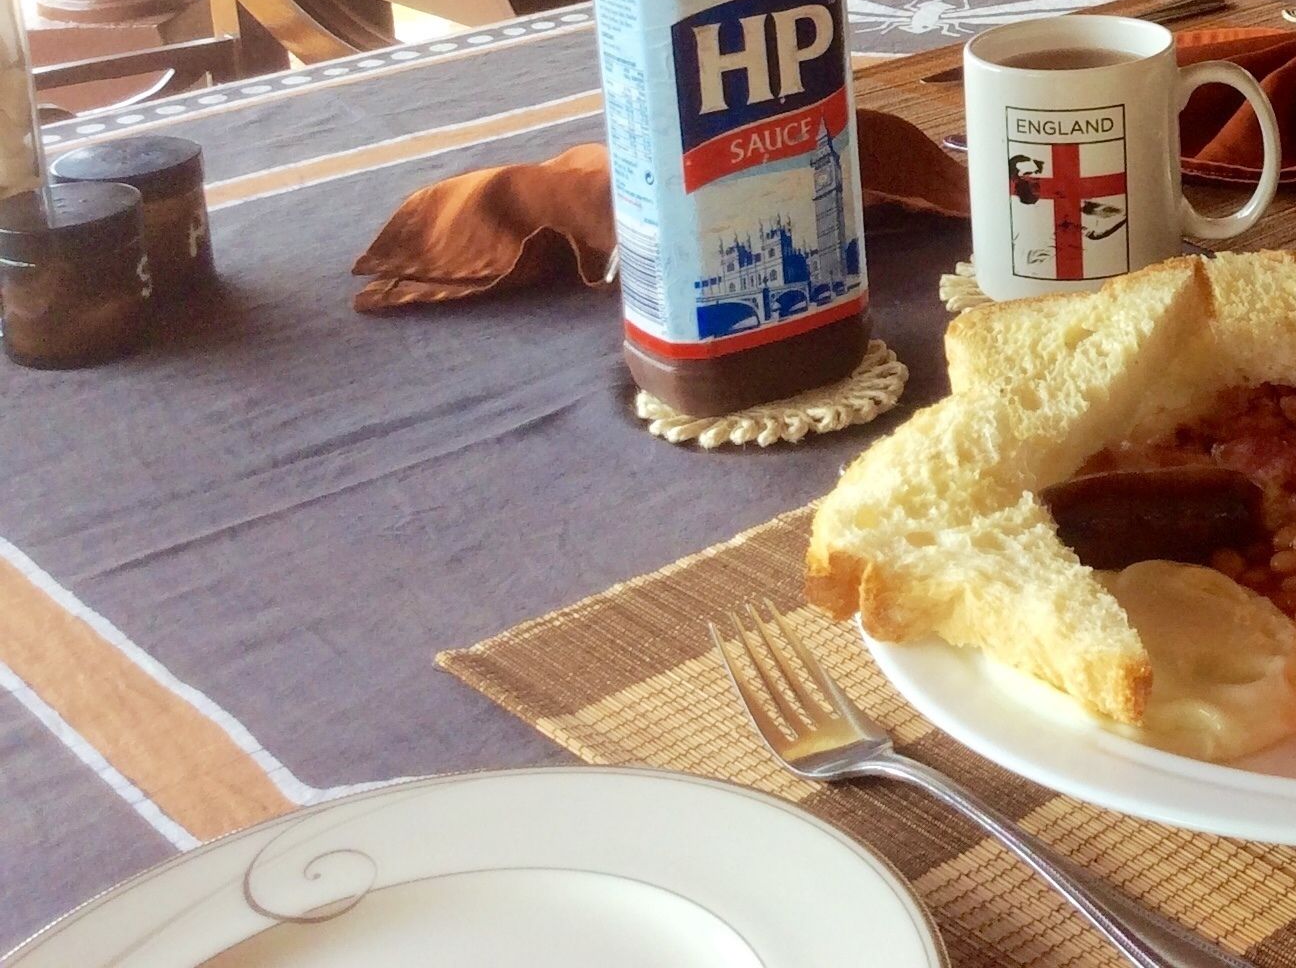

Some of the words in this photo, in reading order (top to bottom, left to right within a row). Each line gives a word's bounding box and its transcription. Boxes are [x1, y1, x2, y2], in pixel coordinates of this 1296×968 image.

[692, 4, 834, 115] HP
[730, 117, 812, 164] SAUCE
[1016, 117, 1114, 136] ENGLAND
